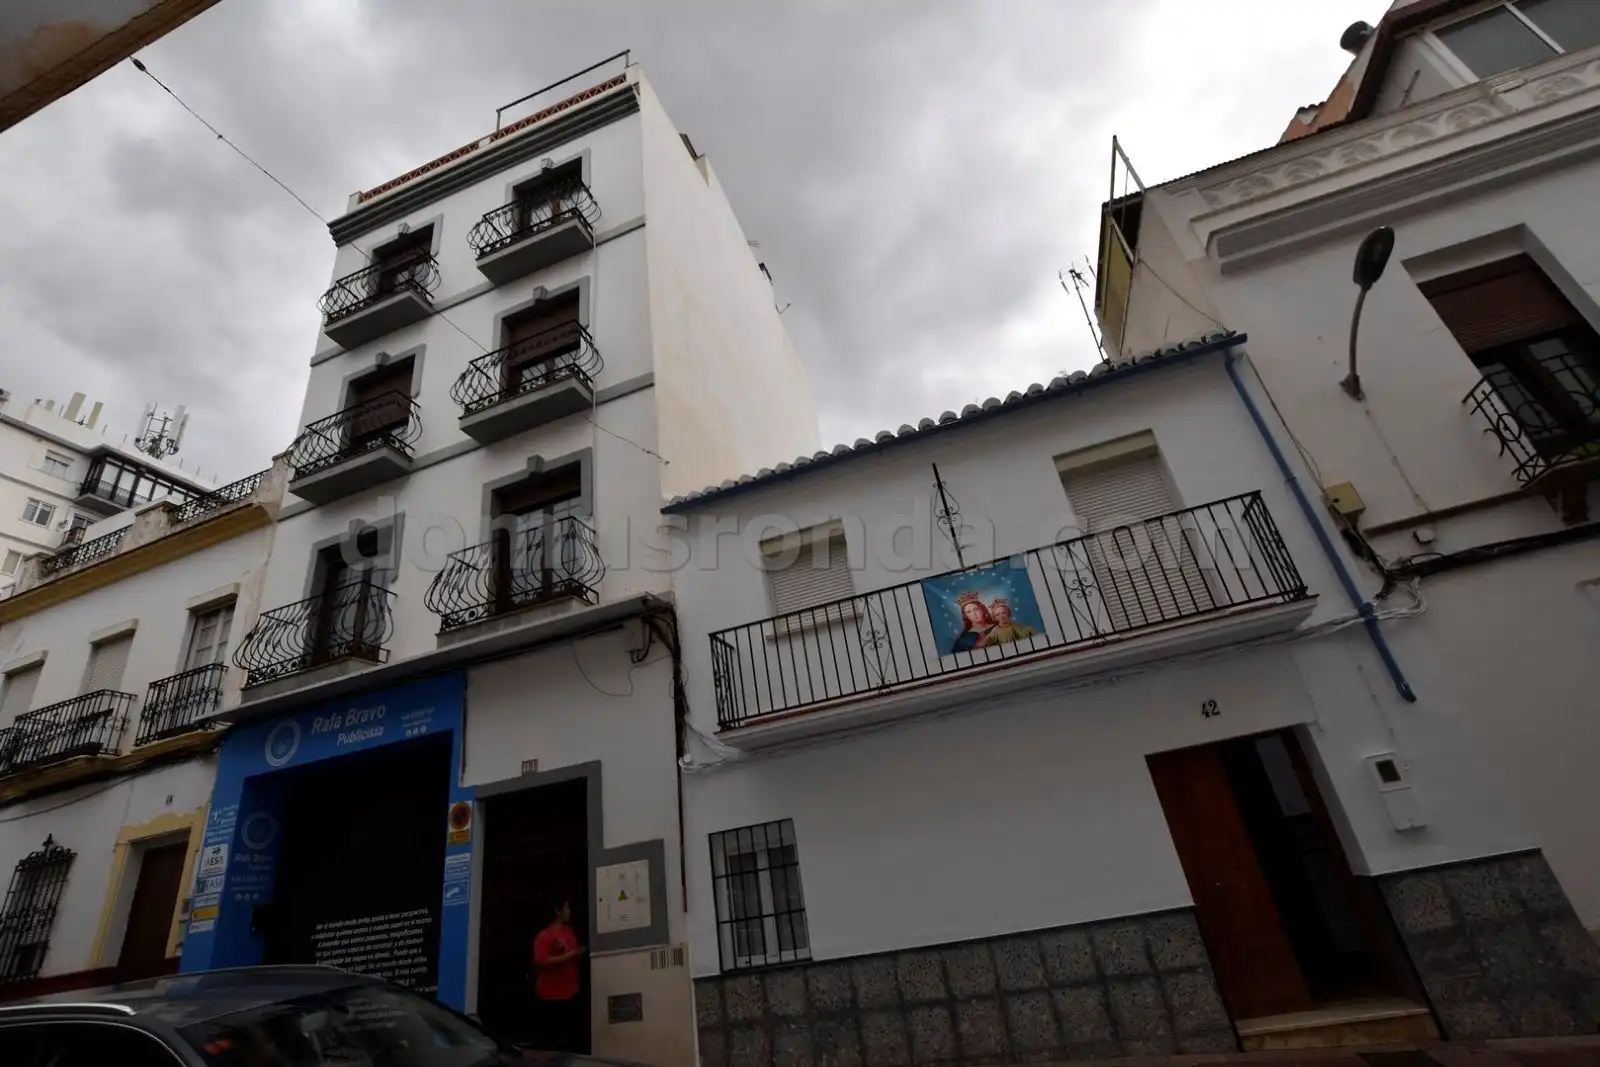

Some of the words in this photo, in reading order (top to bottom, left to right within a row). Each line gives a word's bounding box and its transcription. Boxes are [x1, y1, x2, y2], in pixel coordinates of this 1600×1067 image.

[311, 712, 343, 735] Rafa
[345, 704, 386, 728] Bravo
[1201, 700, 1220, 718] 42
[336, 726, 384, 747] Publicista
